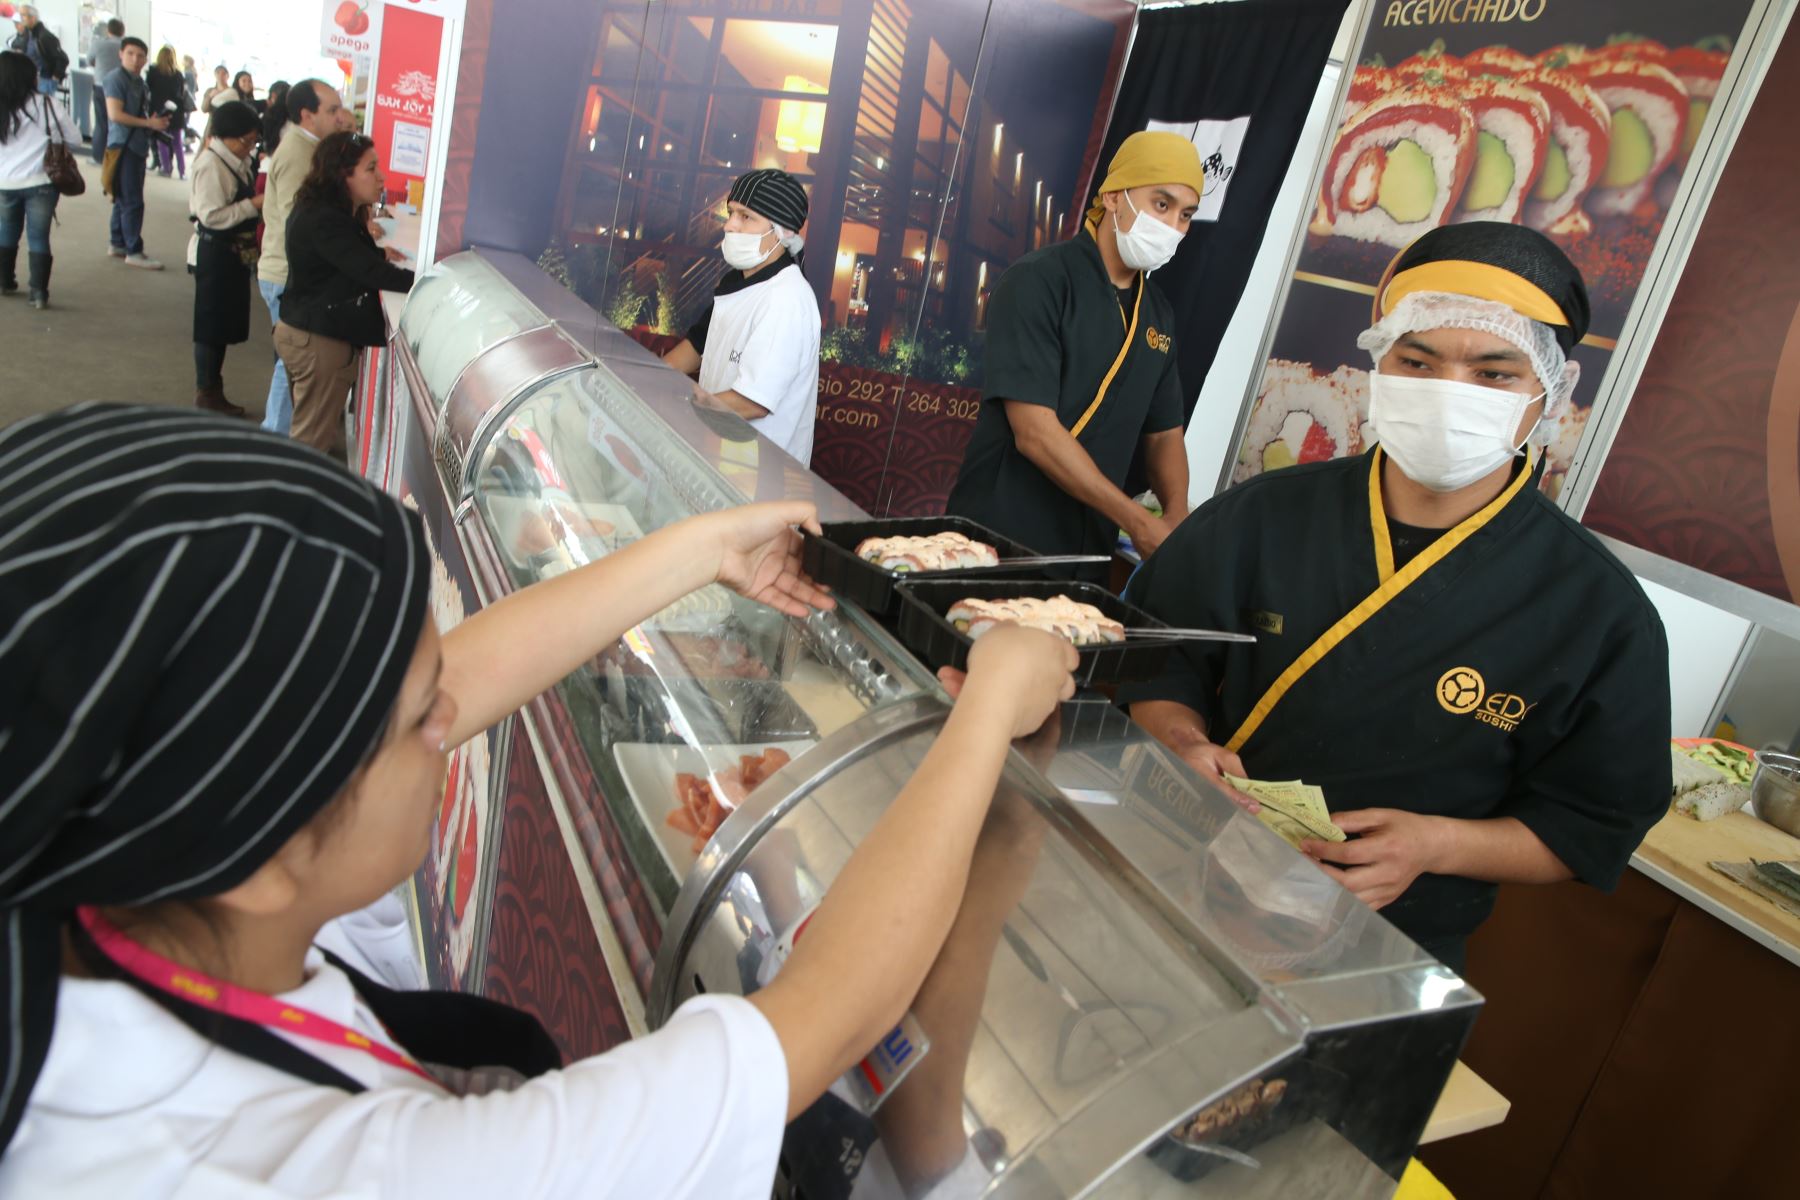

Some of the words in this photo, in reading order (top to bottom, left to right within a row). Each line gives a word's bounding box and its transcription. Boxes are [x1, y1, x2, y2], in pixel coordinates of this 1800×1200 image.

[1384, 0, 1547, 27] ACEVICHADO
[330, 34, 370, 51] apega
[847, 379, 885, 403] 292
[891, 386, 906, 406] T
[907, 391, 941, 414] 264
[946, 398, 981, 421] 302
[1474, 712, 1514, 733] SUSHI
